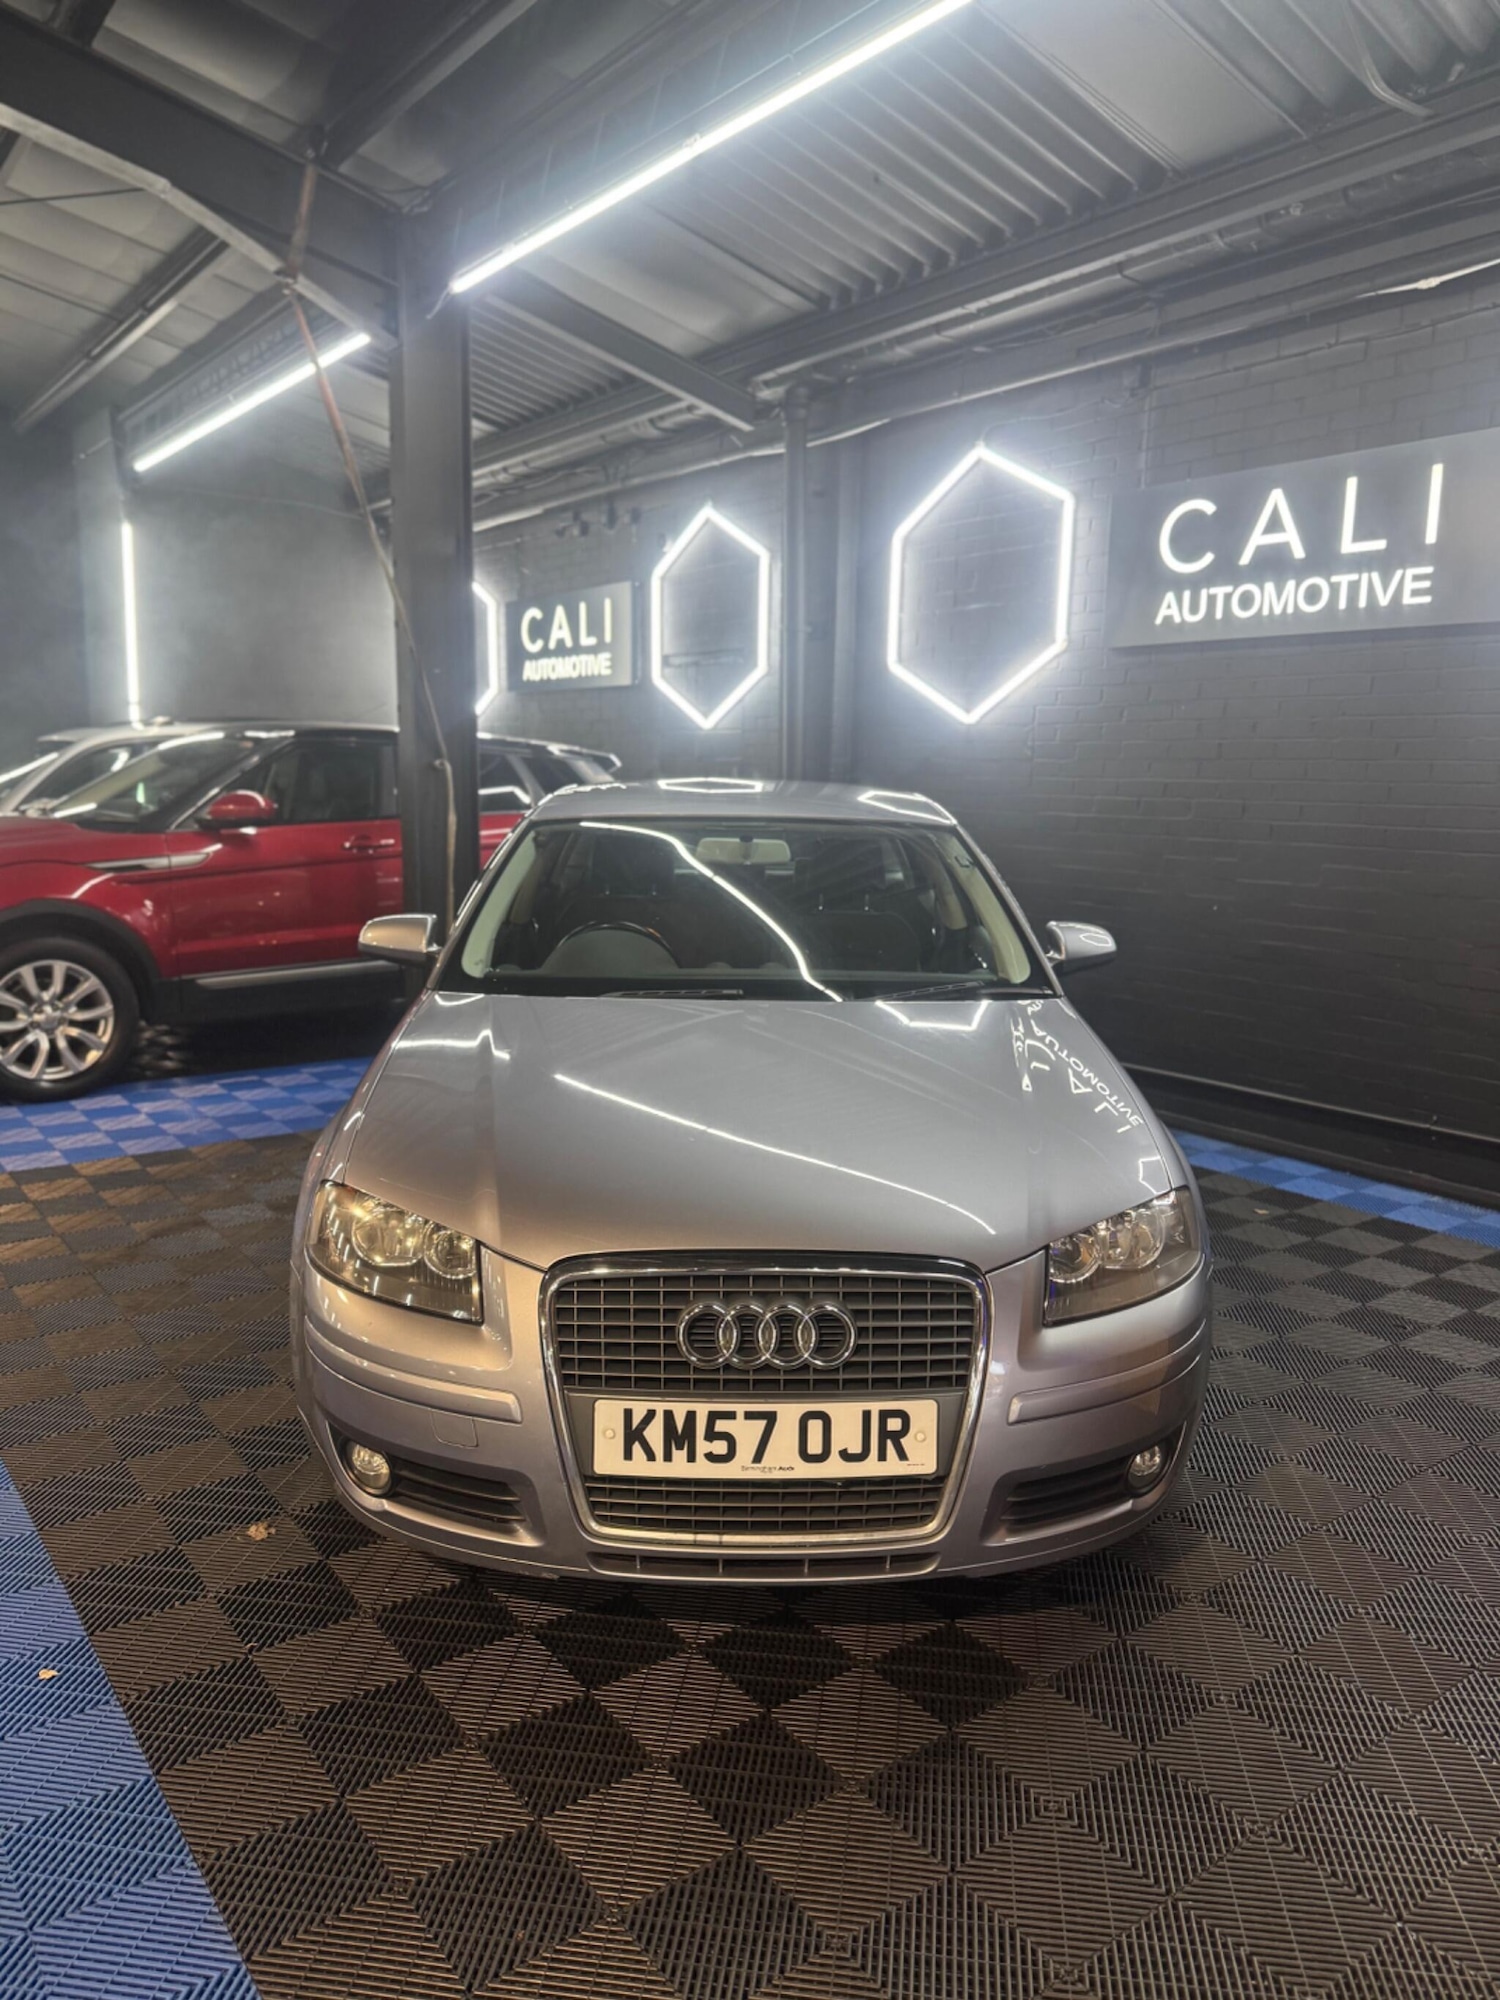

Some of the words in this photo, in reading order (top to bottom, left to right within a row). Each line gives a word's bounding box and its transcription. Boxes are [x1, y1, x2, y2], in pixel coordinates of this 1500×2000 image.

[1159, 463, 1444, 574] CALI
[1154, 566, 1435, 625] AUTOMOTIVE
[520, 597, 612, 653] CALI
[522, 651, 612, 682] AUTOMOTIVE
[623, 1408, 777, 1464] KM57
